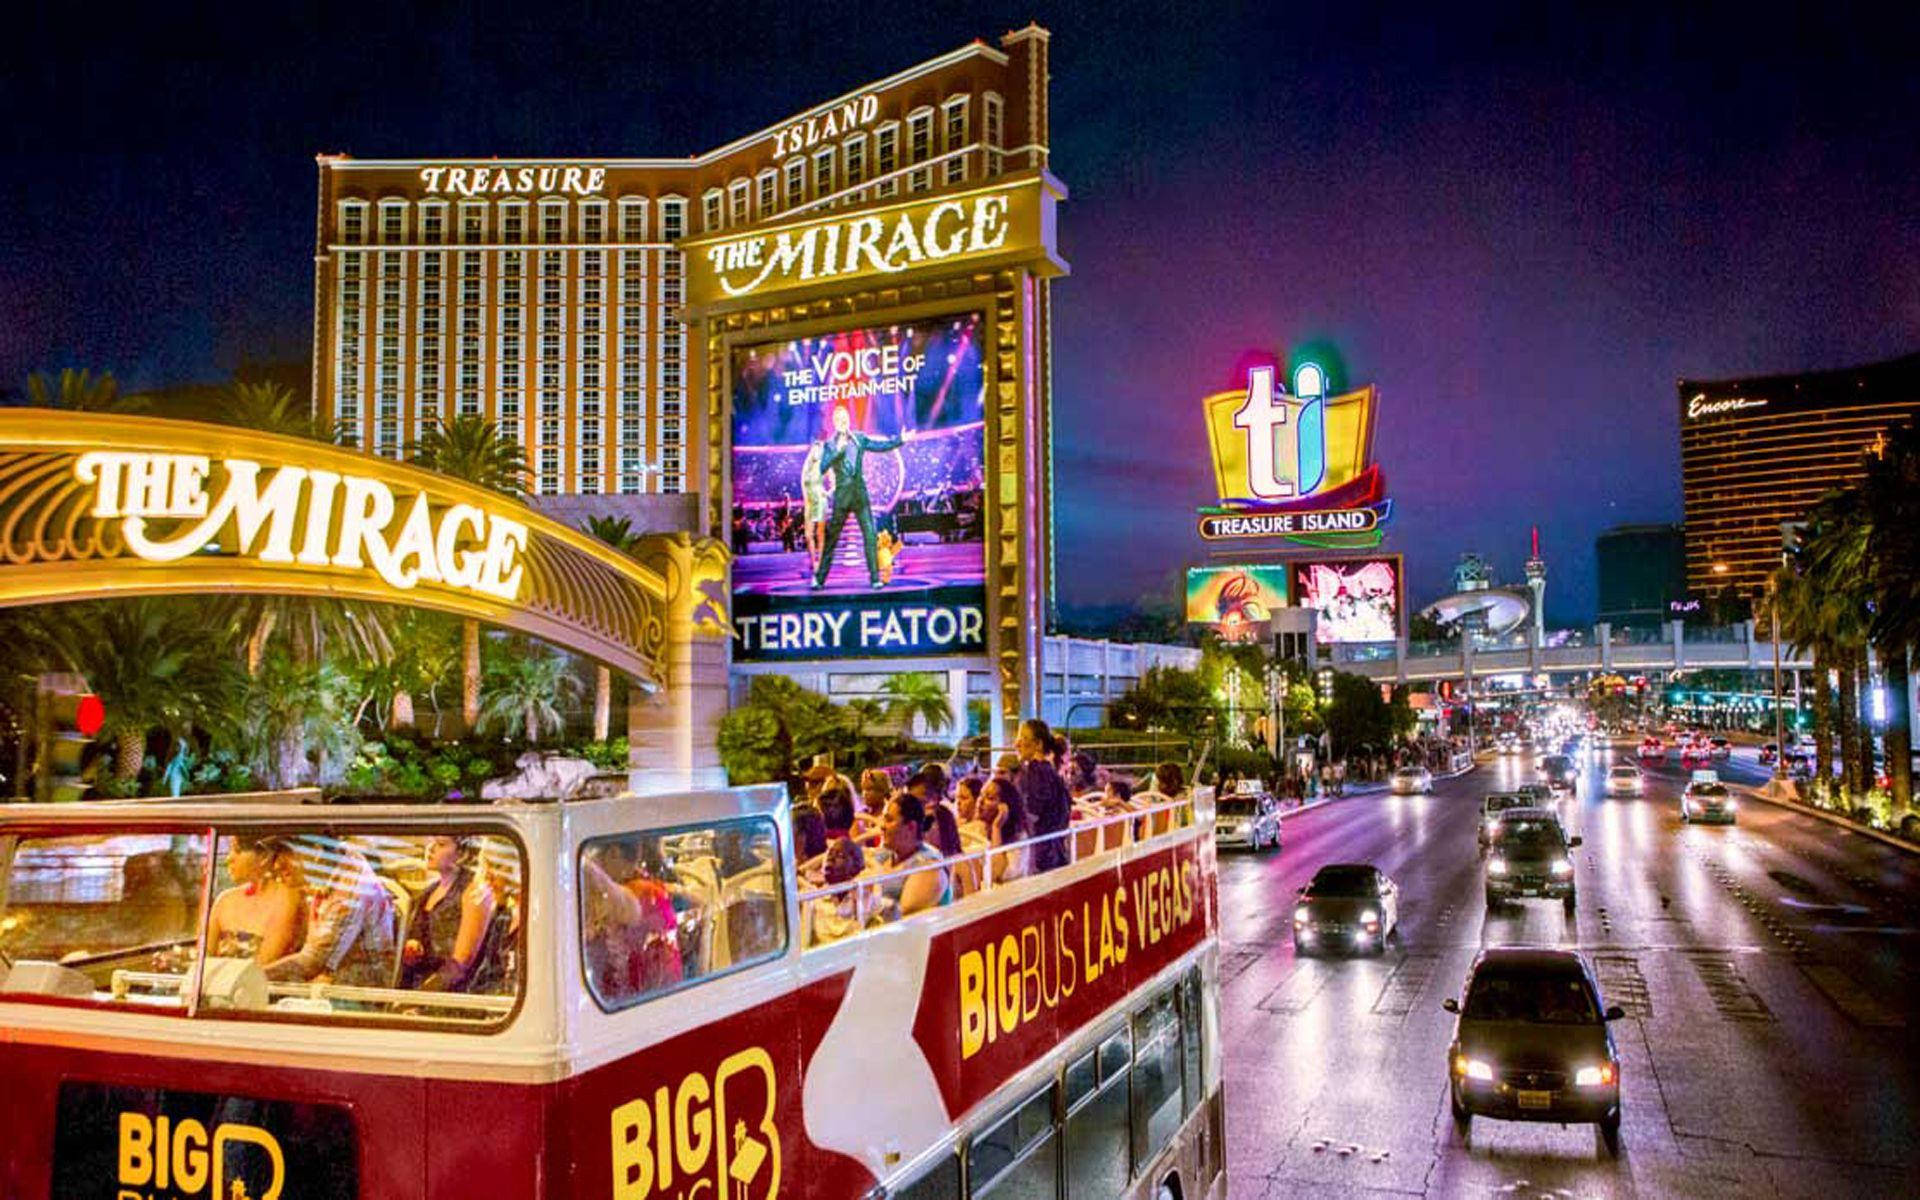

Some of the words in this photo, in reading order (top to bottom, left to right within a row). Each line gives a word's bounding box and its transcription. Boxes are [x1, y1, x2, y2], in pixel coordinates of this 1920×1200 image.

[420, 167, 606, 195] TREASURE
[772, 95, 878, 160] ISLAND
[708, 237, 766, 274] THE
[720, 195, 1009, 297] MIRAGE
[783, 368, 813, 388] THE
[811, 344, 900, 383] VOICE
[902, 354, 926, 374] OF
[788, 374, 918, 406] ENTERTAINMENT
[1688, 393, 1768, 418] Encore
[74, 451, 211, 518] THE
[122, 458, 528, 600] MIRAGE
[1211, 516, 1294, 536] TREASURE
[1302, 511, 1365, 531] ISLAND
[736, 609, 851, 651] TERRY
[860, 606, 984, 648] FATOR
[1083, 886, 1129, 985] LAS
[1133, 859, 1193, 950] VEGAS
[118, 1112, 210, 1194] BIG
[611, 1071, 713, 1200] BIG
